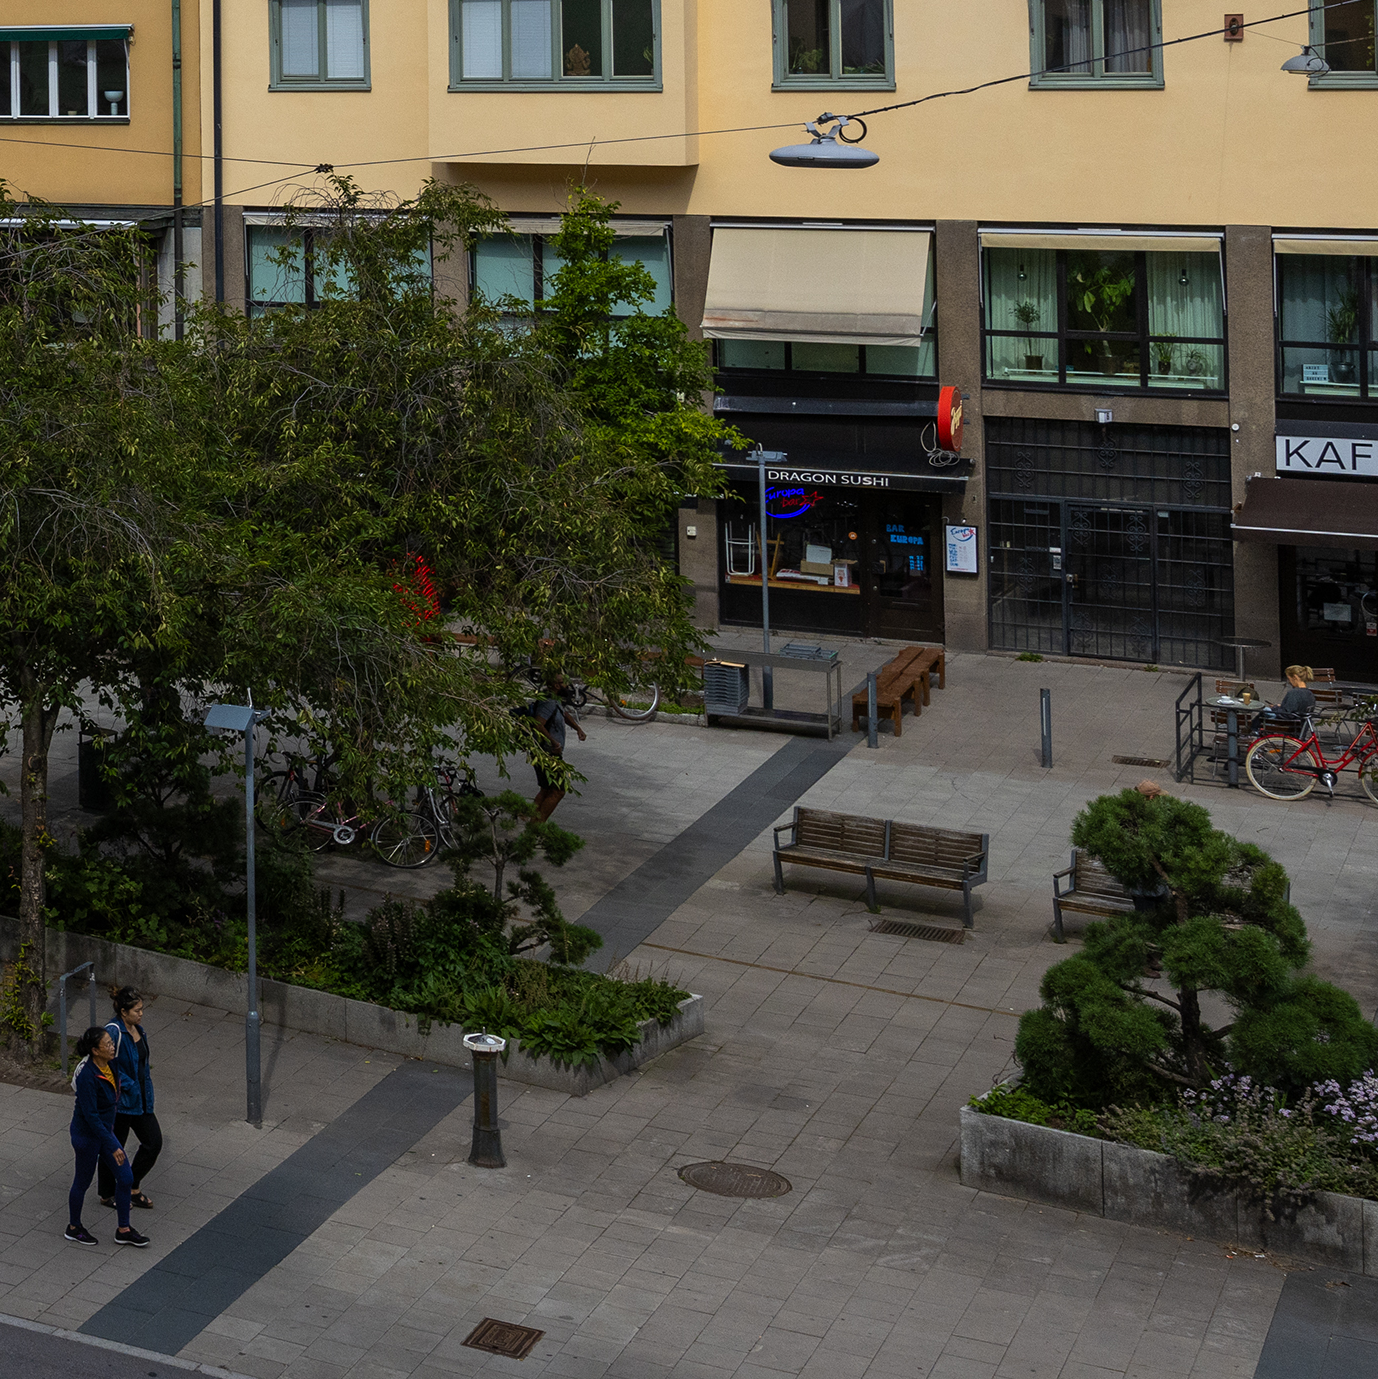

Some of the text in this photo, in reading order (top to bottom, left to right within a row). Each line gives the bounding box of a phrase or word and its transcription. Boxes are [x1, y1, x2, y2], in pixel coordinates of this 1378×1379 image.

[1285, 439, 1373, 471] KAF
[767, 470, 889, 487] DRAGON SUSHI
